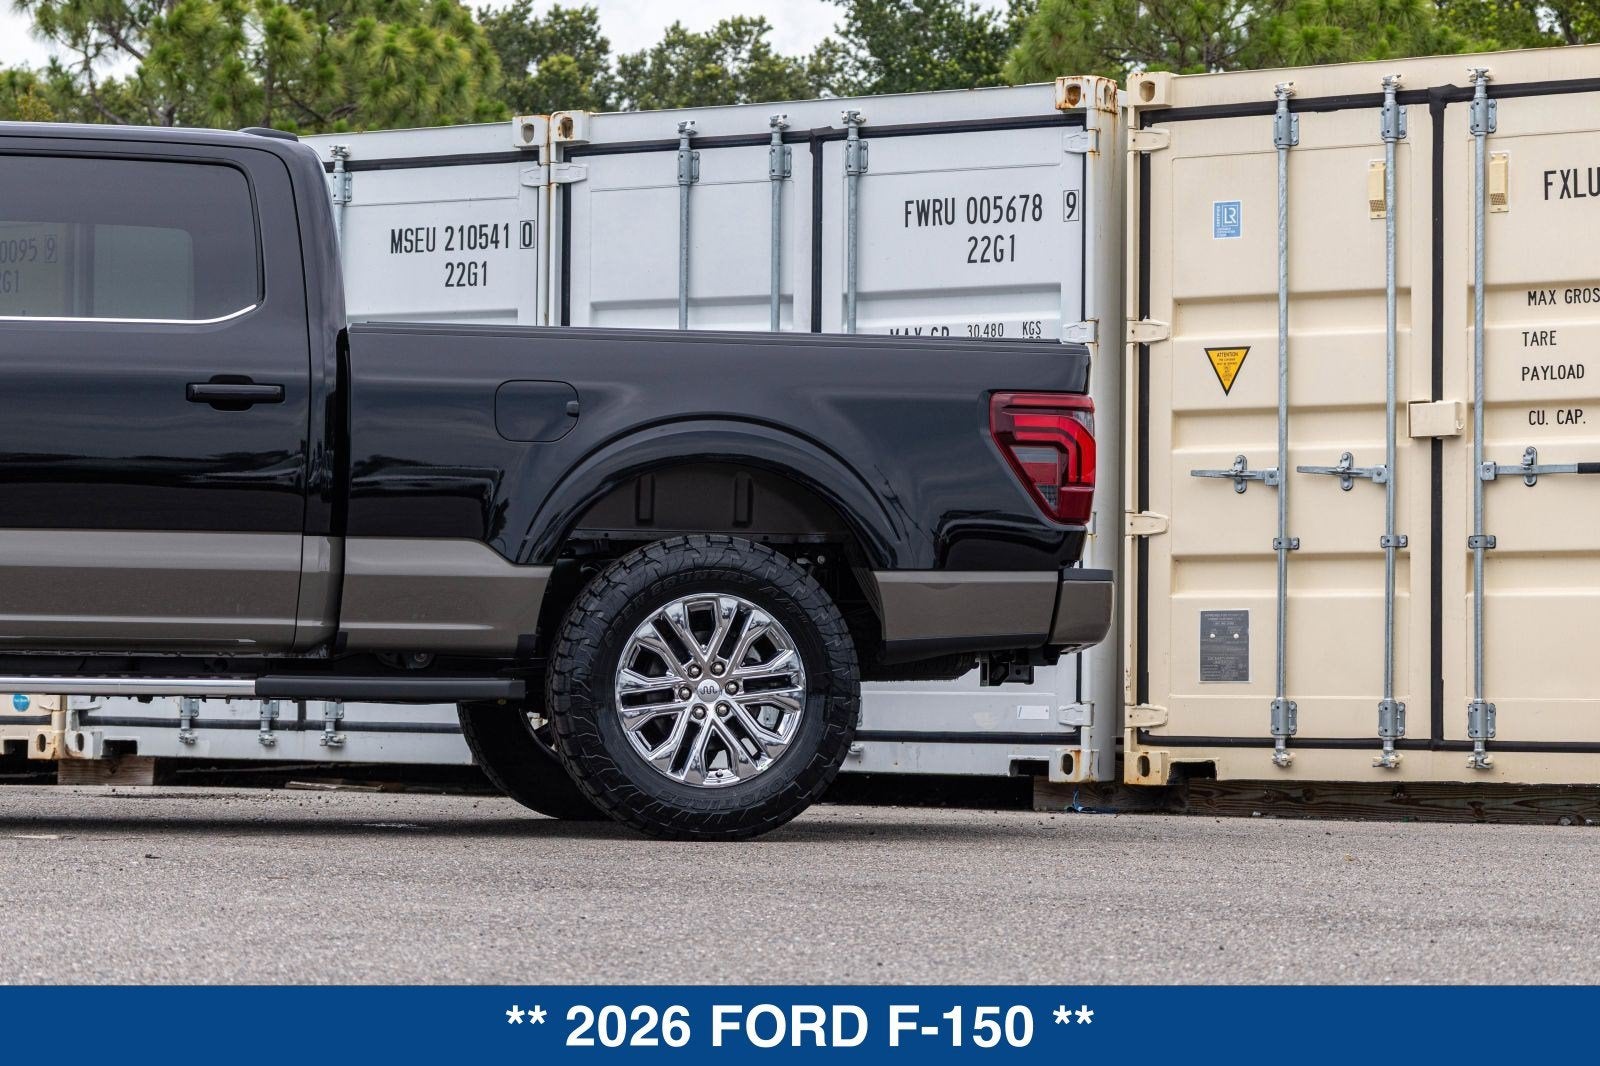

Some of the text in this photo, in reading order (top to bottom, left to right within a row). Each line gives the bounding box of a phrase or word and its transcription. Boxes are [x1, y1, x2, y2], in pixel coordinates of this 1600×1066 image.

[1544, 167, 1600, 200] FXLU
[905, 191, 1077, 228] FWRU 005678 9
[391, 226, 436, 254] MSEU
[445, 222, 509, 252] 210541
[968, 235, 1014, 264] 22G1
[0, 270, 19, 294] G1
[444, 261, 487, 288] 22G1
[1527, 289, 1557, 307] MAX
[1022, 320, 1042, 336] KGS
[1522, 330, 1557, 347] TARE
[1521, 364, 1585, 381] PAYLOAD
[1528, 409, 1586, 426] CU. CAP.
